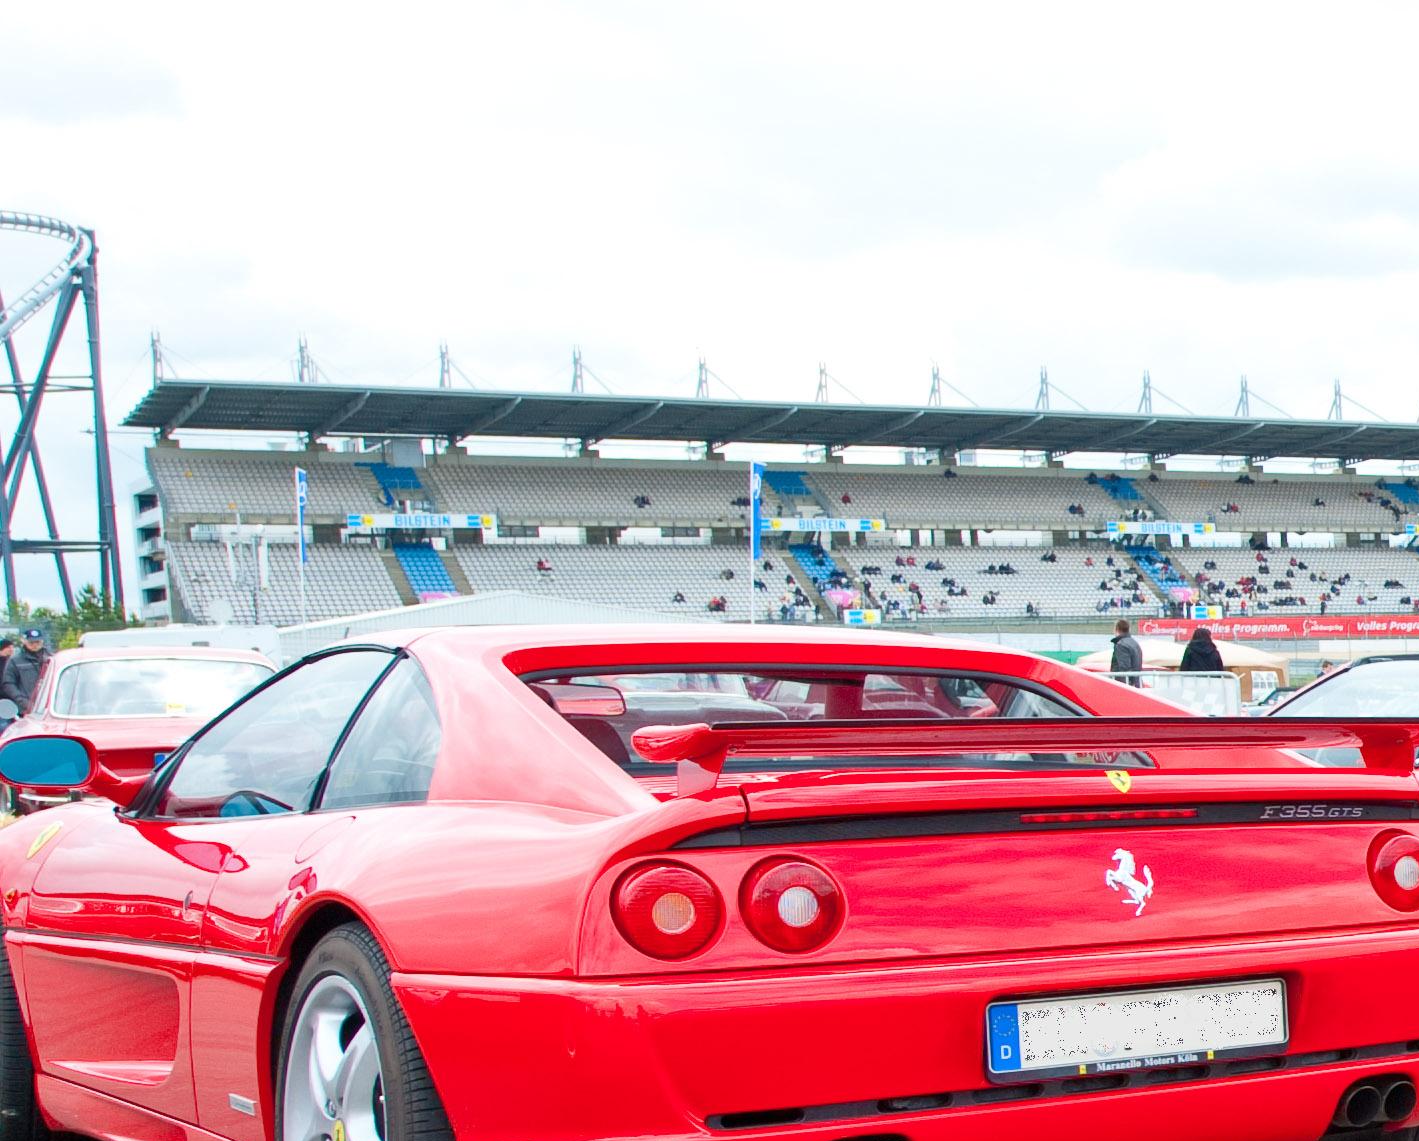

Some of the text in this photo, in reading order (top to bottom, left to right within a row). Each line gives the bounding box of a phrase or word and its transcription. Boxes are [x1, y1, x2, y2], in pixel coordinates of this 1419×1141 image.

[394, 515, 450, 526] BILSTEIN
[798, 520, 847, 530] BILSTEIN
[1234, 624, 1290, 635] Programm.
[1357, 621, 1387, 631] Volles
[1000, 1044, 1012, 1060] D
[1096, 1059, 1142, 1072] Maranello
[1144, 1056, 1175, 1067] Motors
